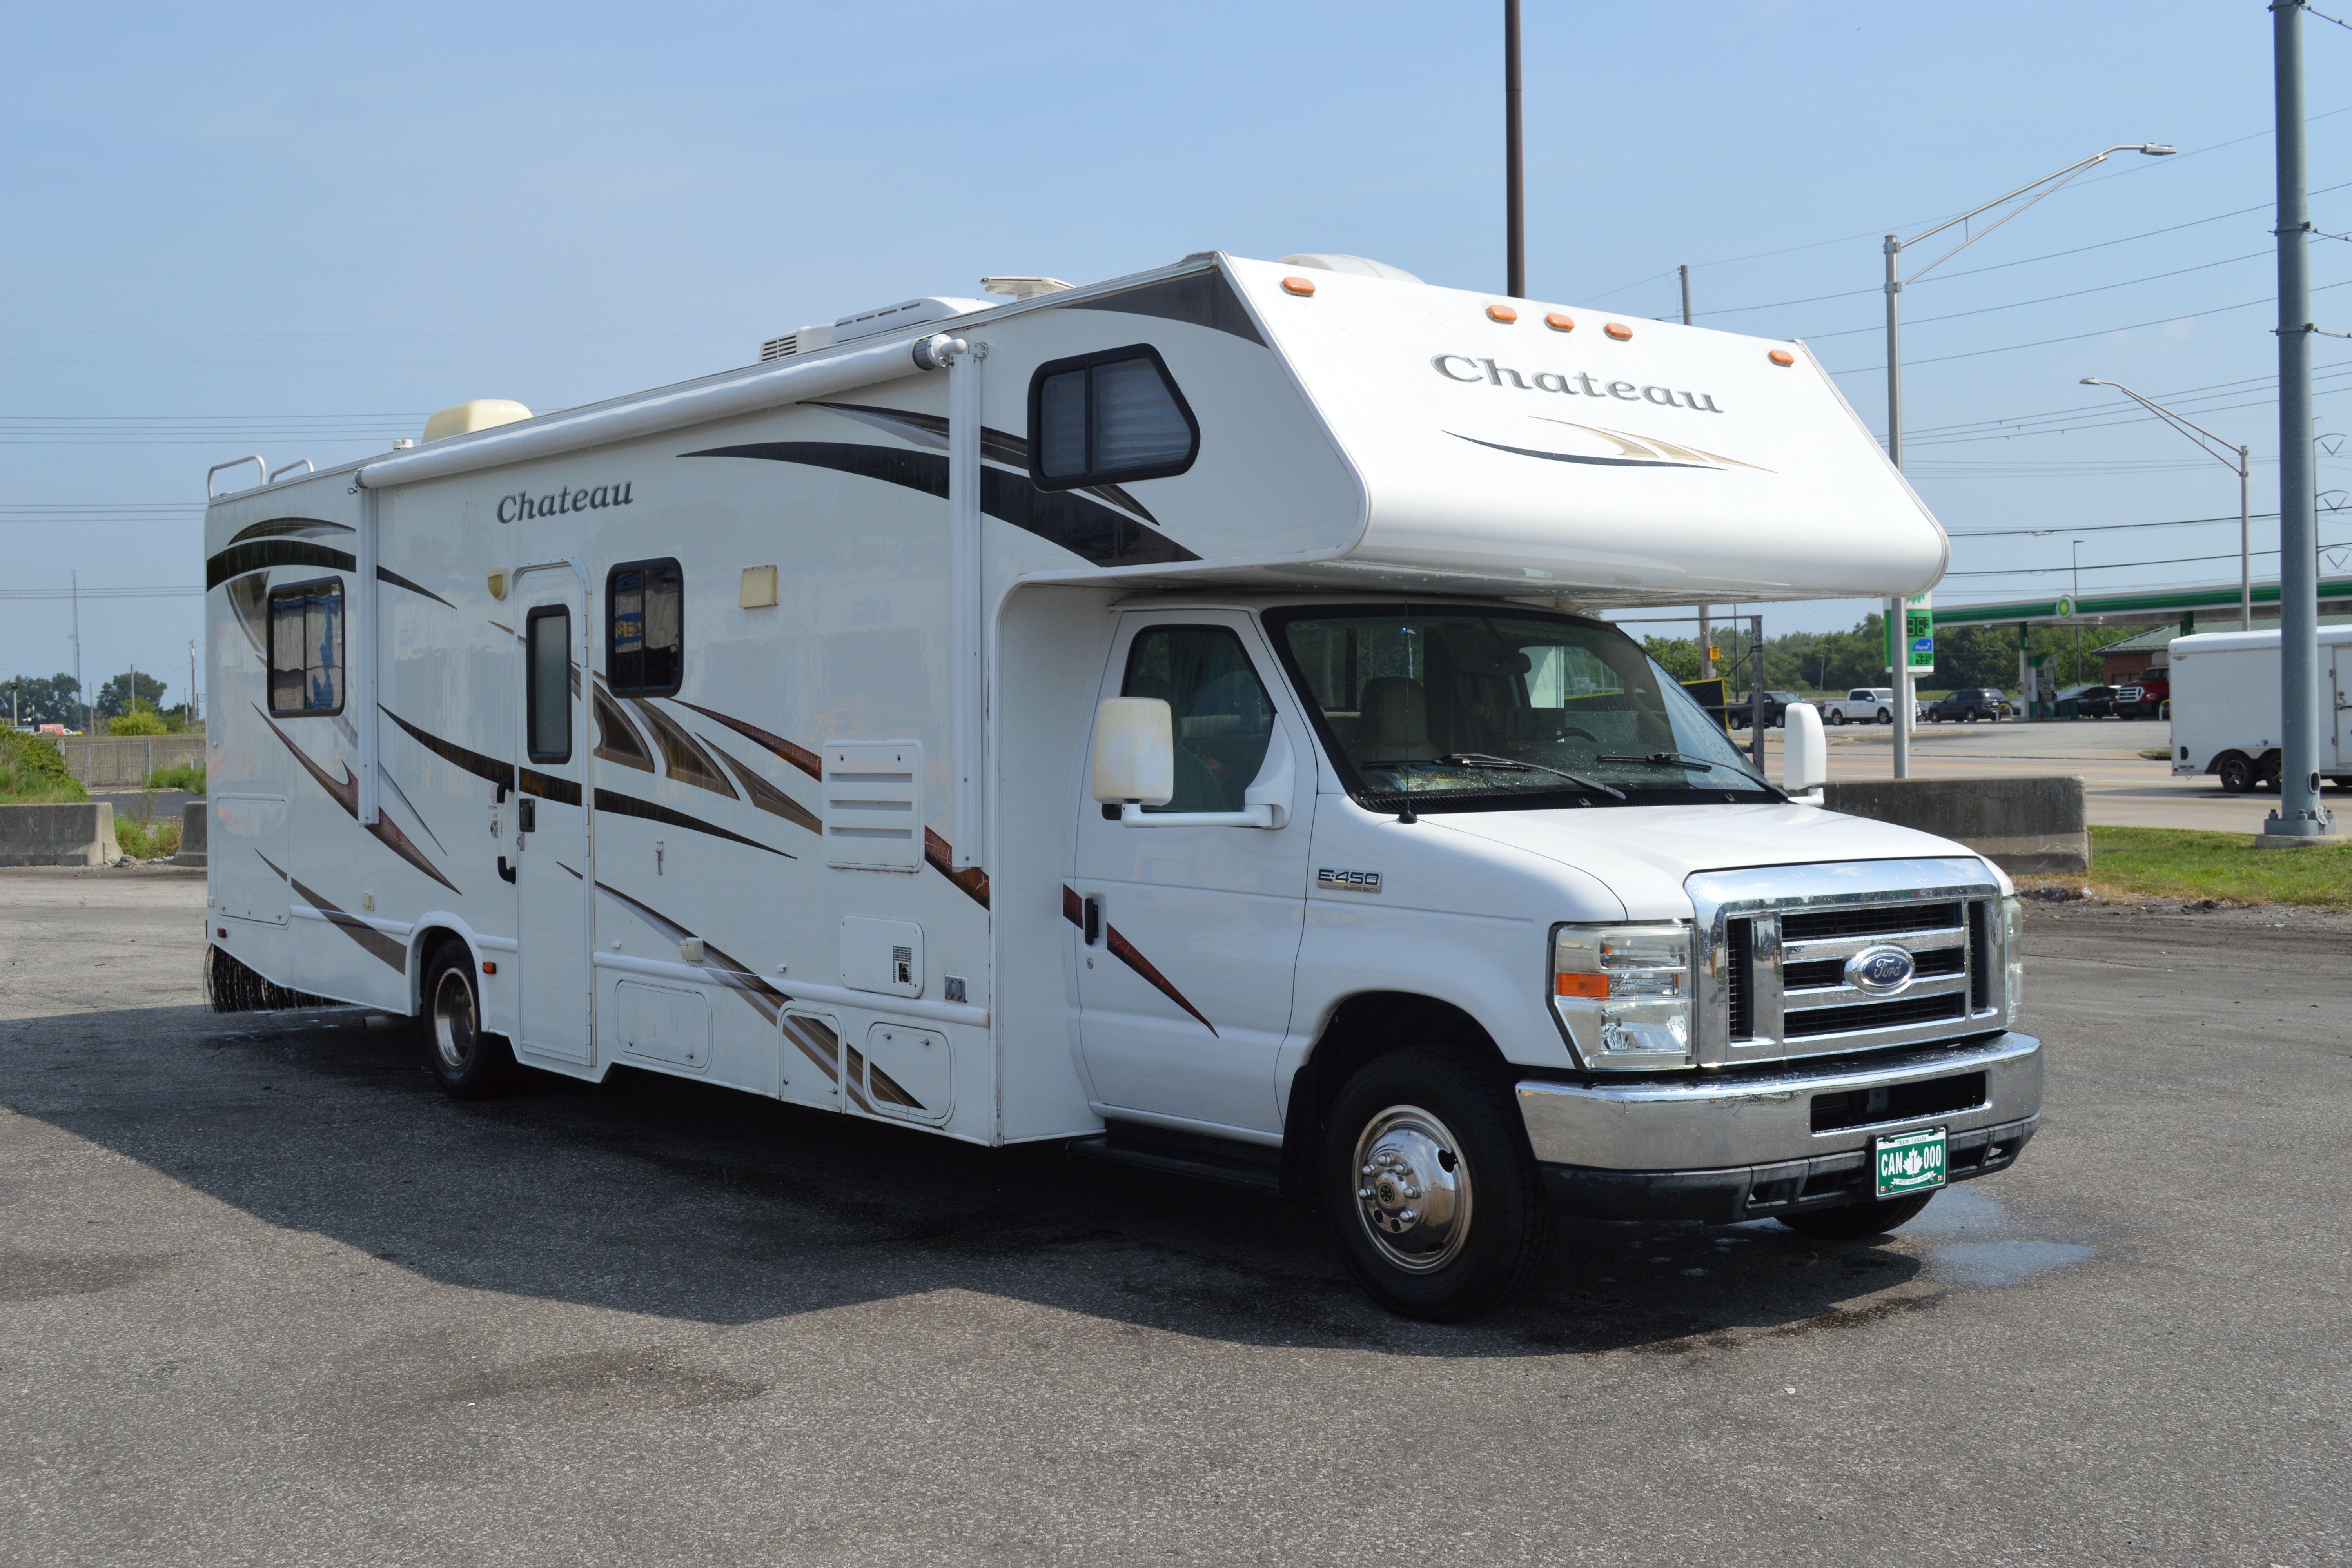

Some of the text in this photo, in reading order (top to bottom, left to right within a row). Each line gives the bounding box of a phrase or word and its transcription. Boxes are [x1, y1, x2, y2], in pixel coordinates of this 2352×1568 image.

[1430, 353, 1725, 414] Chateau
[496, 481, 633, 524] Chateau
[1874, 958, 1902, 978] Ford
[1881, 1151, 1902, 1177] CAN
[1924, 1144, 1942, 1169] 000
